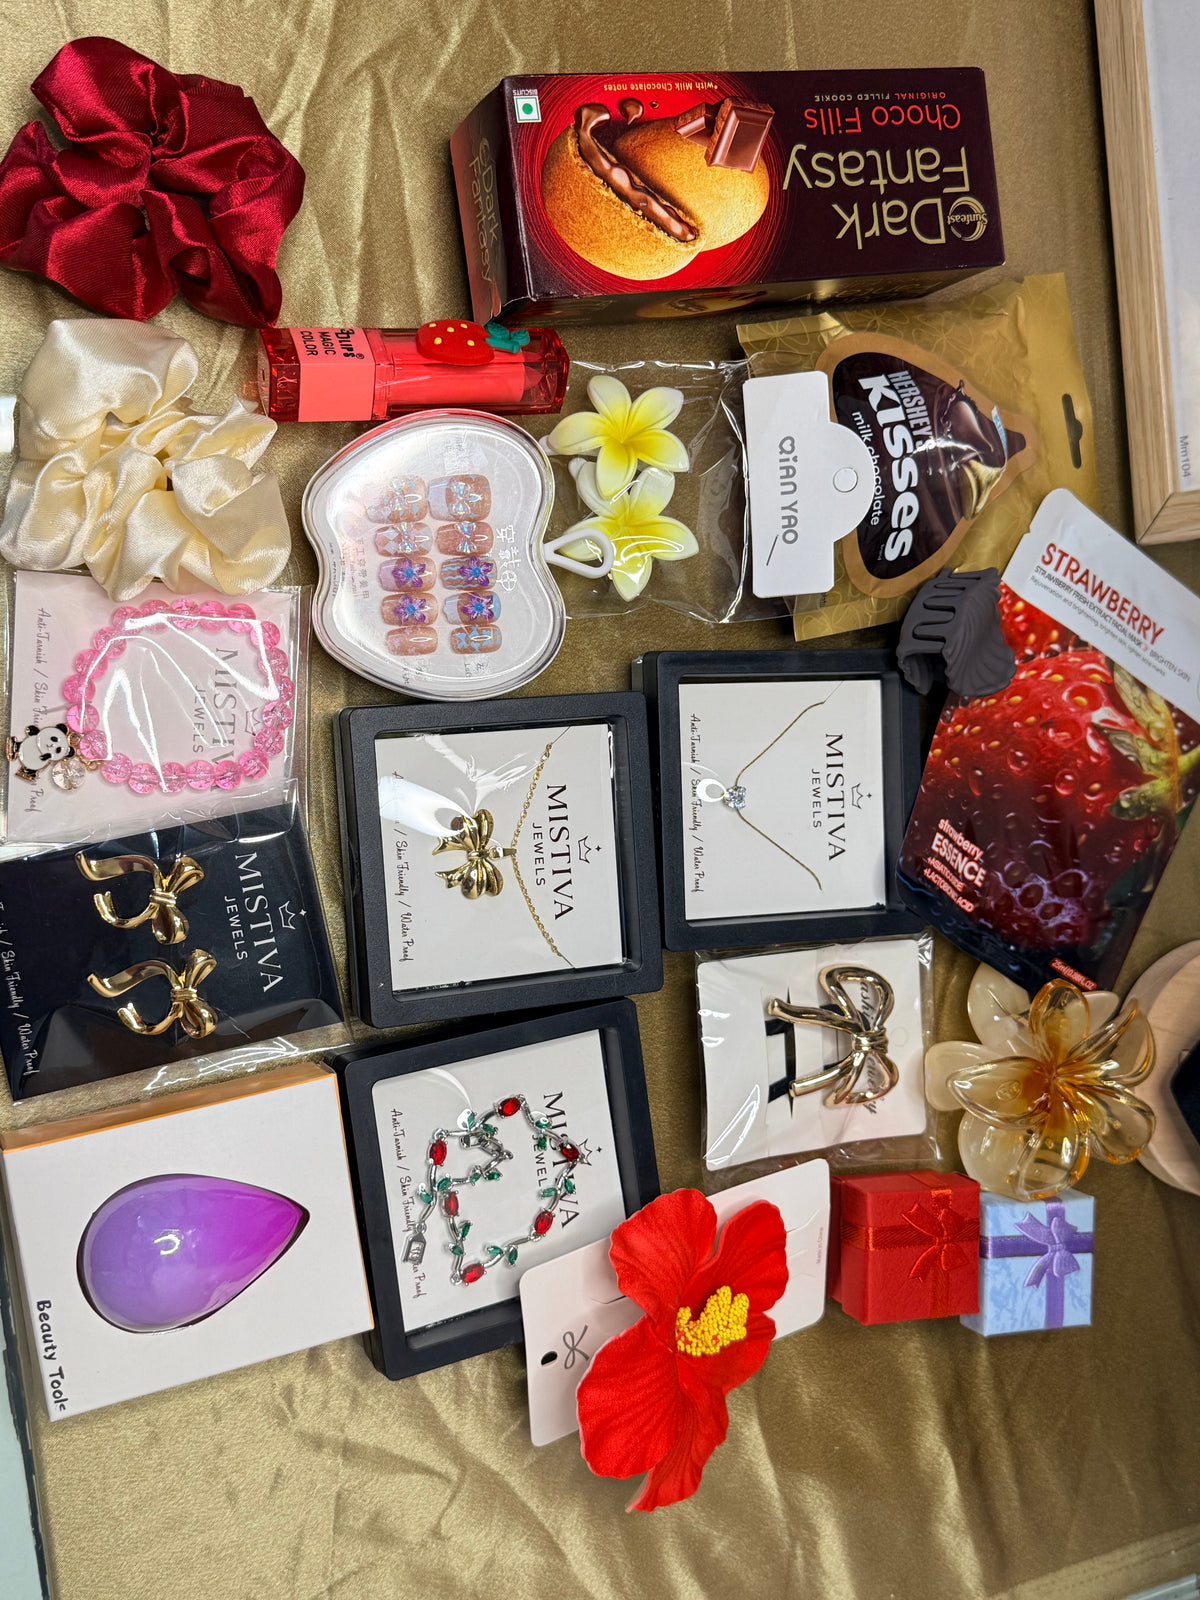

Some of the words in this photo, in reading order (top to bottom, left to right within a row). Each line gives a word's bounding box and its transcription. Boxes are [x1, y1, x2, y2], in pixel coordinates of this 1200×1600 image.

[512, 88, 538, 97] BISCUITS
[603, 83, 628, 92] notes
[630, 82, 672, 92] Chocolate
[675, 81, 693, 91] Milk
[814, 94, 853, 102] COOKIE
[857, 93, 890, 101] FILLED
[894, 91, 946, 101] ORIGINAL
[803, 106, 862, 136] Fills
[871, 104, 961, 131] Choco
[782, 144, 970, 196] Fantasy
[469, 156, 493, 283] Fantasy
[482, 165, 499, 247] Dark
[947, 212, 988, 226] Sunfeast
[831, 197, 947, 251] Dark
[300, 330, 318, 356] COLOR
[318, 331, 337, 356] MAGIC
[851, 411, 875, 443] milk
[780, 500, 799, 545] YAO
[1034, 565, 1073, 595] STRAWBERRY
[1072, 589, 1090, 606] FRESH
[1088, 599, 1114, 627] EXTRACT
[1128, 630, 1143, 647] MASK
[1041, 542, 1165, 646] STRAWBERRY
[1176, 668, 1192, 683] SKIN
[33, 680, 49, 704] Skin
[192, 685, 207, 754] JEWELS
[210, 647, 239, 793] MISTIV
[690, 713, 702, 764] Anti-Tarnish
[24, 787, 45, 814] Proof
[810, 768, 823, 829] JEWELS
[825, 733, 847, 862] MISTIVA
[688, 798, 703, 832] Friendly
[395, 840, 409, 861] Skin
[532, 821, 547, 887] JEWELS
[546, 783, 575, 921] MISTIVA
[938, 818, 984, 862] strawberry
[693, 846, 705, 871] Water
[931, 831, 987, 888] ESSENCE
[394, 861, 410, 896] Friendly
[691, 871, 706, 894] Proof
[223, 895, 249, 961] JEWELS
[234, 851, 285, 993] MISTIVA
[400, 911, 413, 938] Water
[1, 950, 16, 972] Skin
[398, 938, 415, 963] Proof
[5, 971, 24, 1010] Friendly
[17, 1022, 32, 1050] Water
[23, 1049, 41, 1077] Proof
[390, 1108, 407, 1162] Anti-Tarnish
[531, 1134, 548, 1188] JEWEL
[399, 1175, 413, 1197] Skin
[402, 1196, 417, 1234] Friendly
[412, 1274, 428, 1300] Proof
[36, 1299, 57, 1361] Beauty
